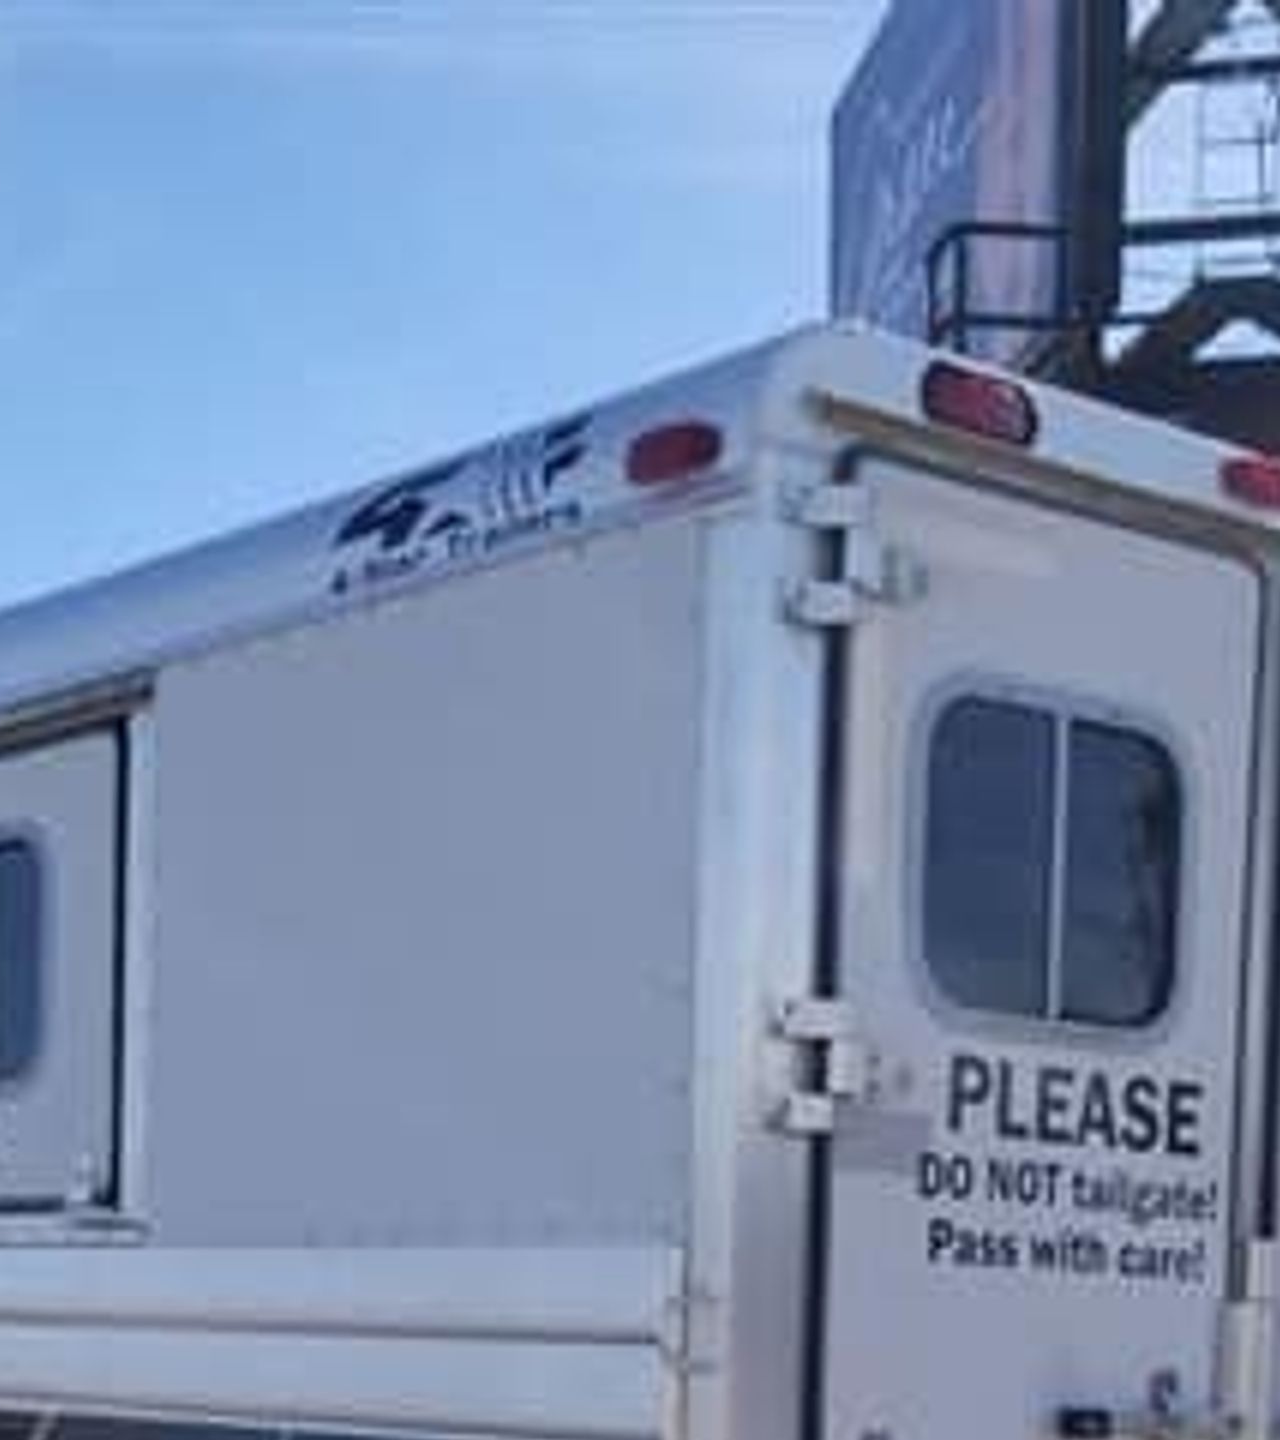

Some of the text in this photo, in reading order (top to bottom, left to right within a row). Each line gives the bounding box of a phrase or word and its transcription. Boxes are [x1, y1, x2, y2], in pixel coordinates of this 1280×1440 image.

[948, 1054, 1203, 1156] PLEASE
[919, 1152, 1217, 1226] DO NOT tailgate!
[927, 1217, 1207, 1284] Pass with care!
